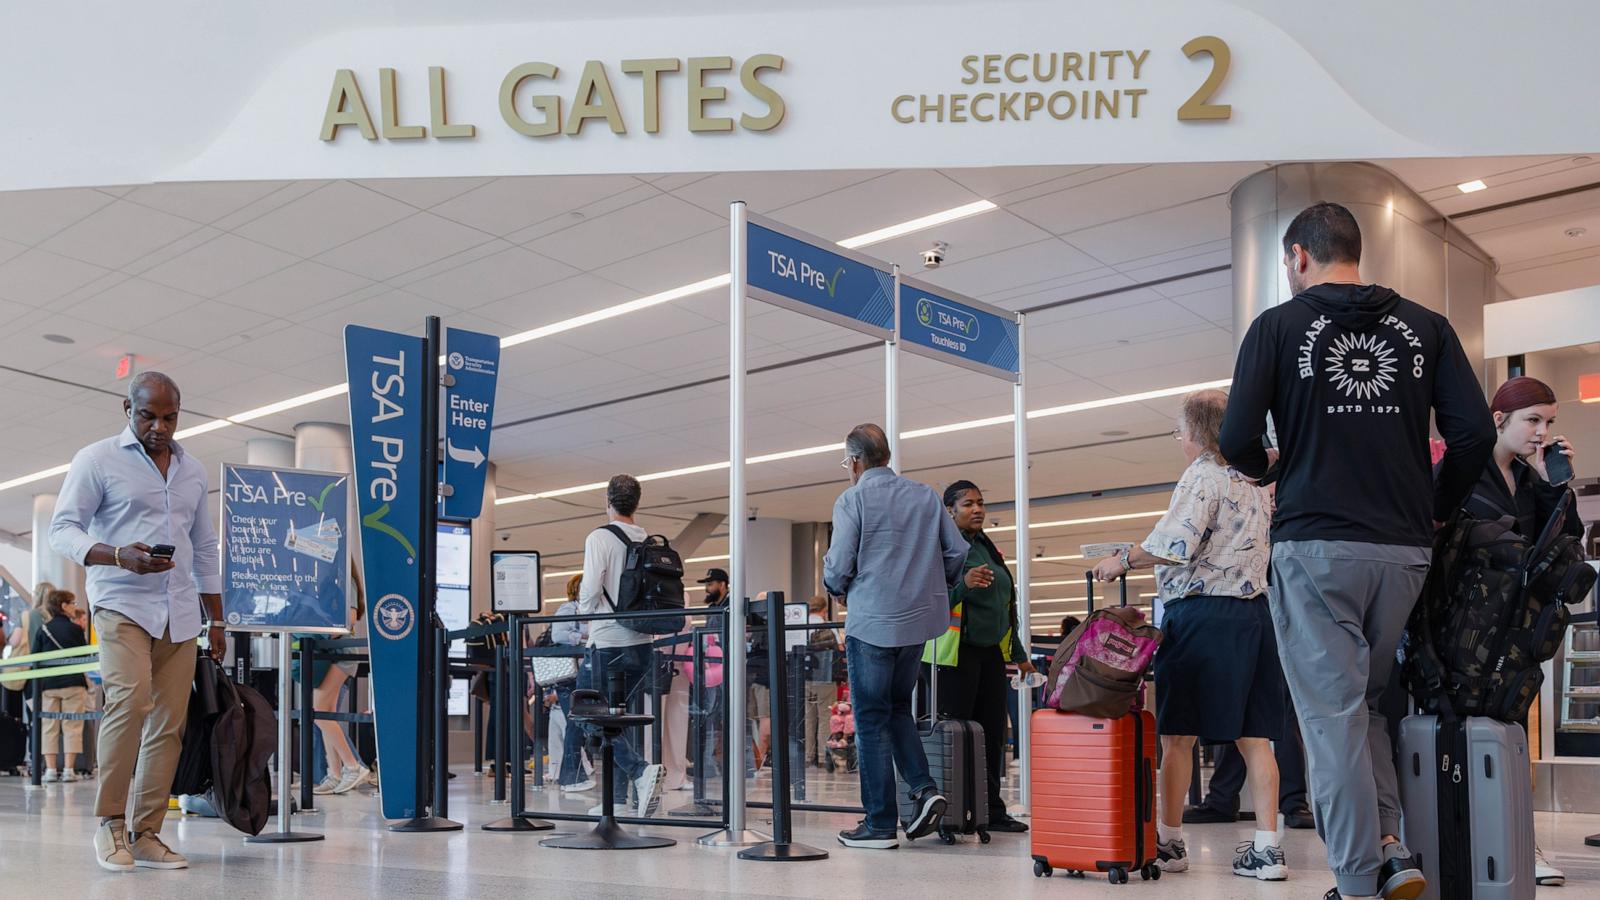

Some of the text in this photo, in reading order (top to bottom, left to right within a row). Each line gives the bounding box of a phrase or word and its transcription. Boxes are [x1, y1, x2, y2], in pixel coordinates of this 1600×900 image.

[961, 49, 1150, 85] SECURITY
[1178, 36, 1232, 121] 2
[319, 54, 786, 141] ALL GATES
[891, 88, 1147, 124] CHECKPOINT
[768, 250, 825, 290] TSA Pre
[938, 312, 965, 331] TSA Pre
[930, 333, 967, 352] Touchless ID
[1298, 314, 1425, 380] BILLABO PPLY CO
[450, 394, 489, 414] Enter
[1327, 405, 1400, 414] ESTD 1973
[370, 350, 405, 502] TSA Pre
[452, 411, 487, 430] Here
[229, 484, 306, 507] TSA Pre
[231, 515, 277, 526] Check your
[231, 525, 269, 535] boarding
[231, 544, 238, 553] if
[241, 547, 256, 555] you
[231, 571, 318, 583] Please proceed to the
[232, 581, 245, 589] TSA
